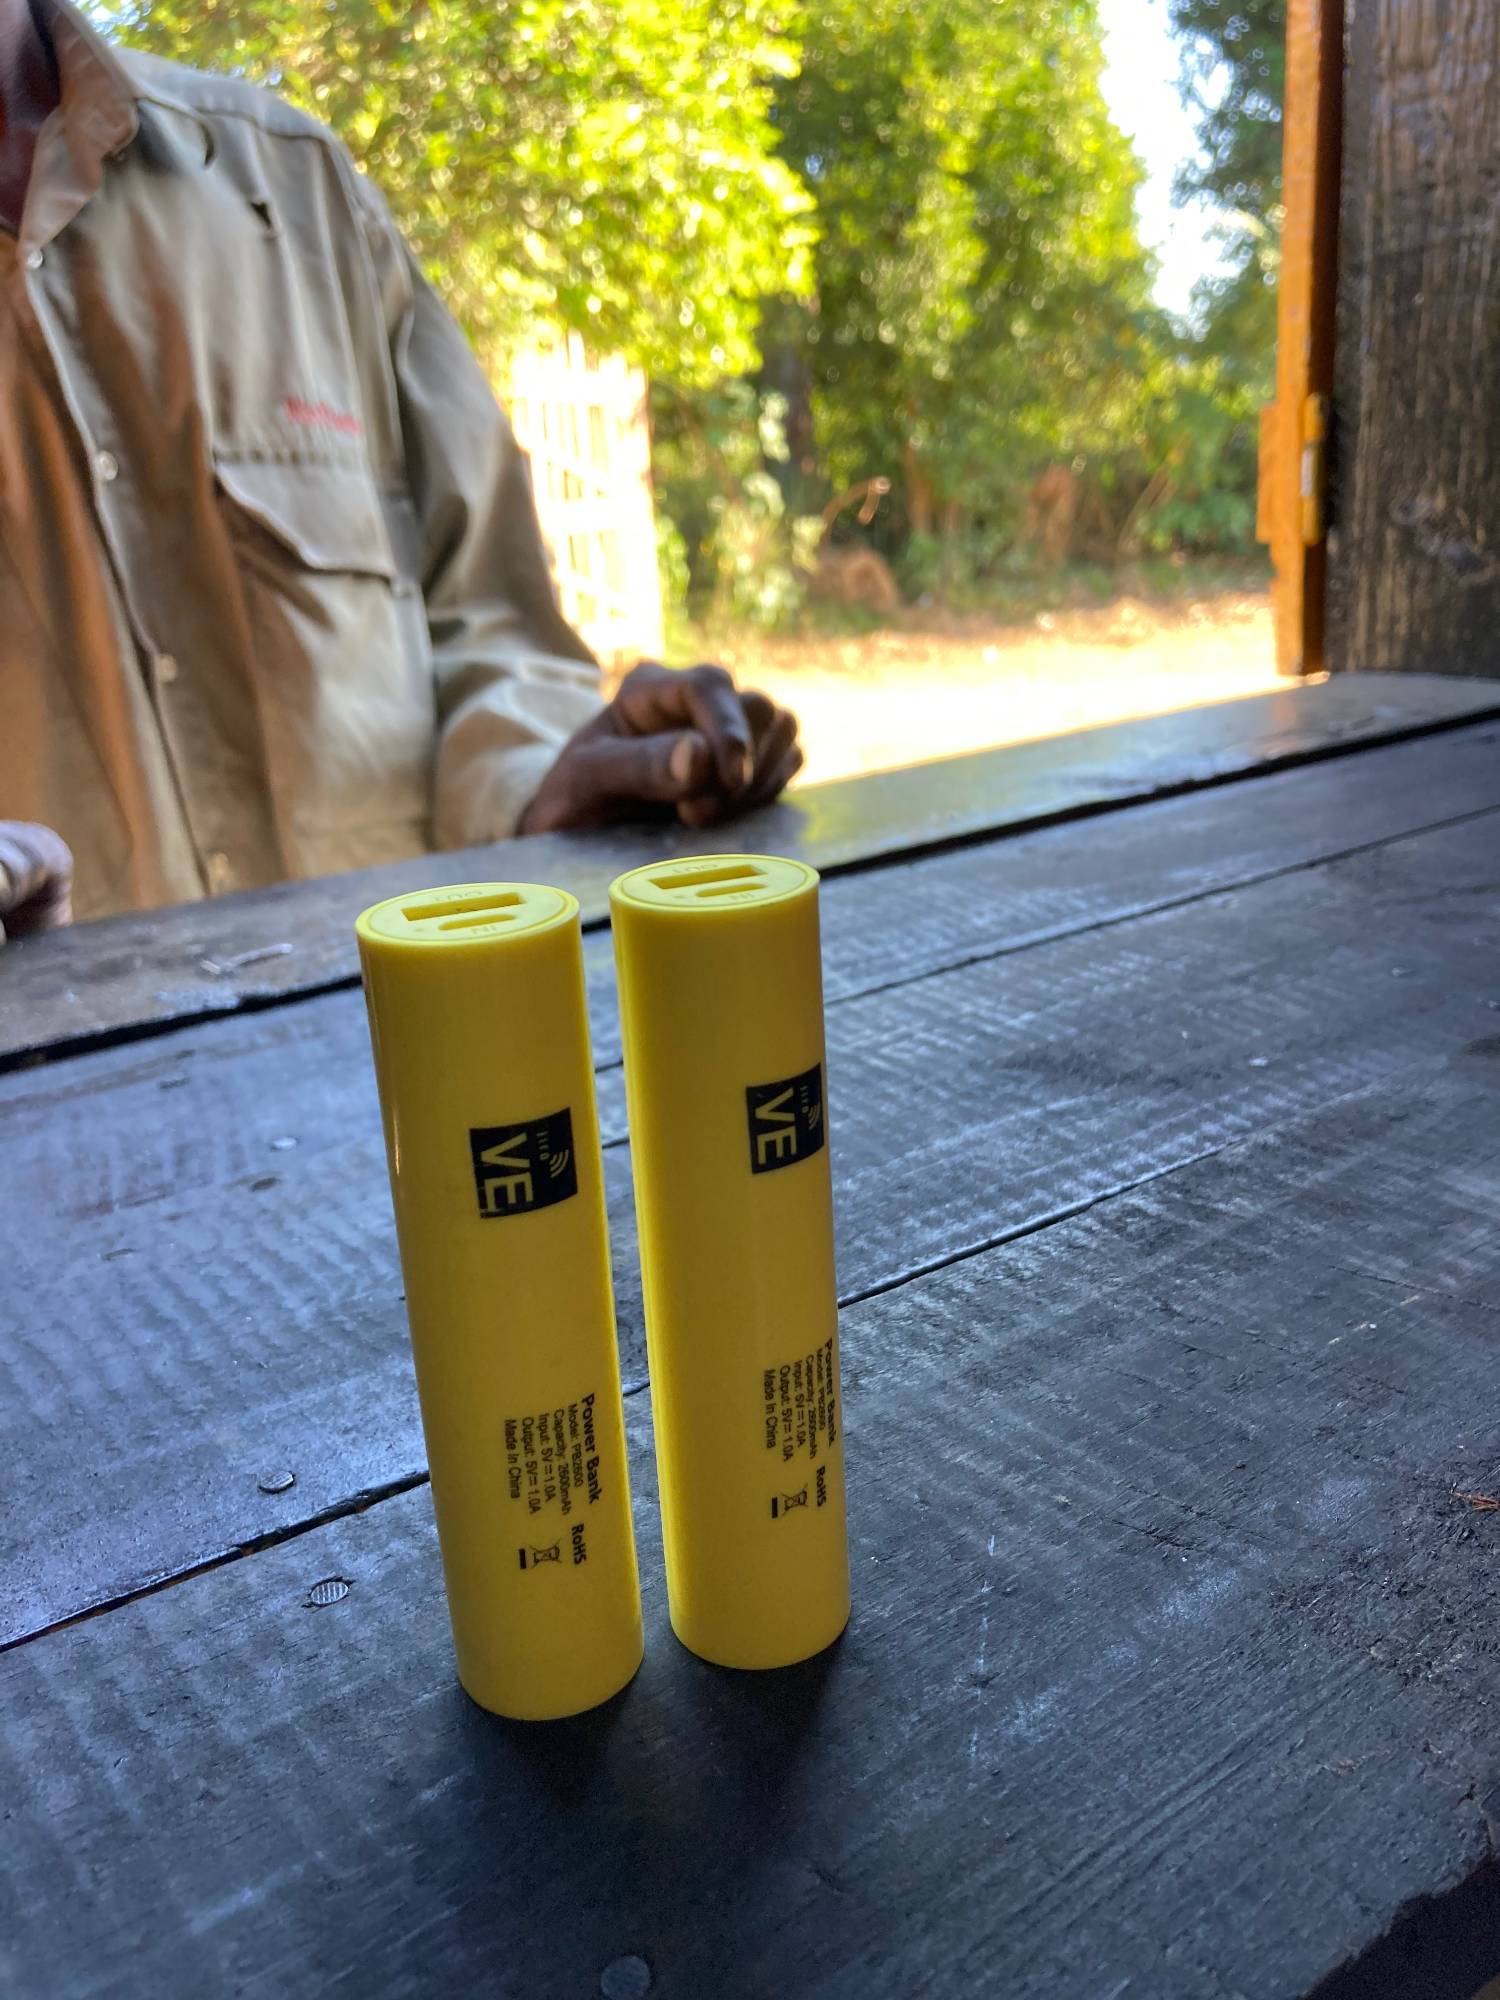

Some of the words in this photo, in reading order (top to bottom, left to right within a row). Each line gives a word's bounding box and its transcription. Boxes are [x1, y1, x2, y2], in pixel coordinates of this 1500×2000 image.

[755, 1086, 797, 1164] VE
[480, 1131, 535, 1213] VE
[763, 1368, 776, 1400] Made
[779, 1364, 791, 1405] Output:
[792, 1359, 803, 1392] Input:
[825, 1336, 833, 1396] Power
[504, 1418, 517, 1451] Made
[520, 1416, 535, 1457] Output:
[536, 1412, 550, 1445] Input:
[553, 1408, 567, 1460] Capacity:
[568, 1403, 580, 1440] Model:
[581, 1392, 595, 1453] Power
[765, 1416, 778, 1449] China
[828, 1399, 837, 1448] Bank
[508, 1466, 521, 1499] China
[558, 1463, 572, 1515] 2600mAh
[586, 1455, 603, 1504] Bank
[816, 1465, 827, 1508] RoHS
[571, 1522, 587, 1565] RoHS
